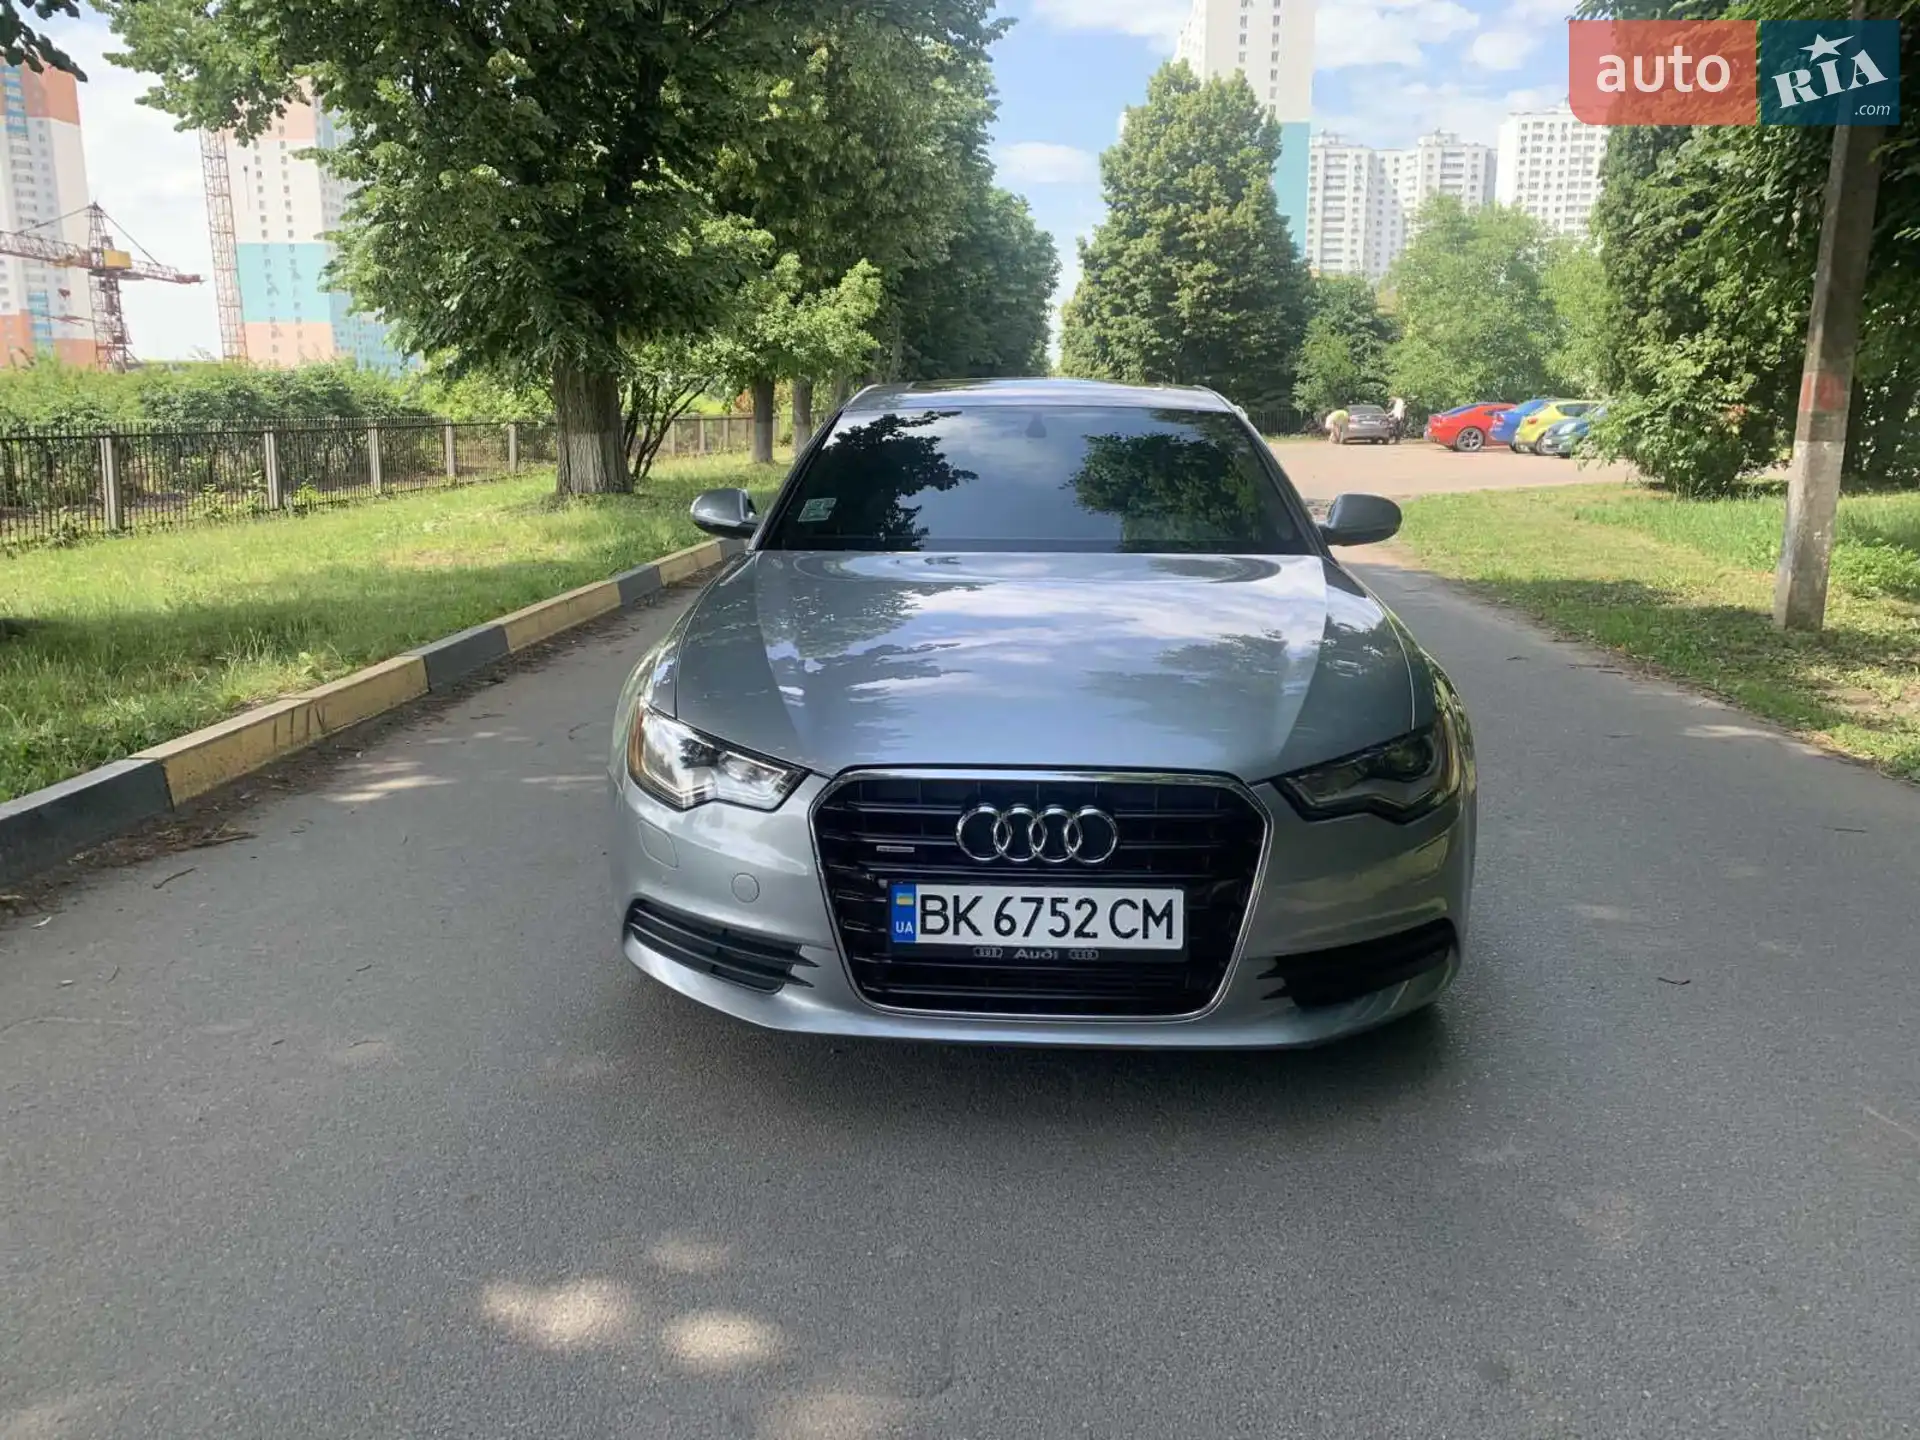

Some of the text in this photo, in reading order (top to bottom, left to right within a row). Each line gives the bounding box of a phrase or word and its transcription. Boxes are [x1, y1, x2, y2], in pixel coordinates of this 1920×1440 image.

[920, 894, 1174, 940] BK 6752 CM
[895, 920, 914, 935] UA
[1013, 948, 1059, 960] Audi
